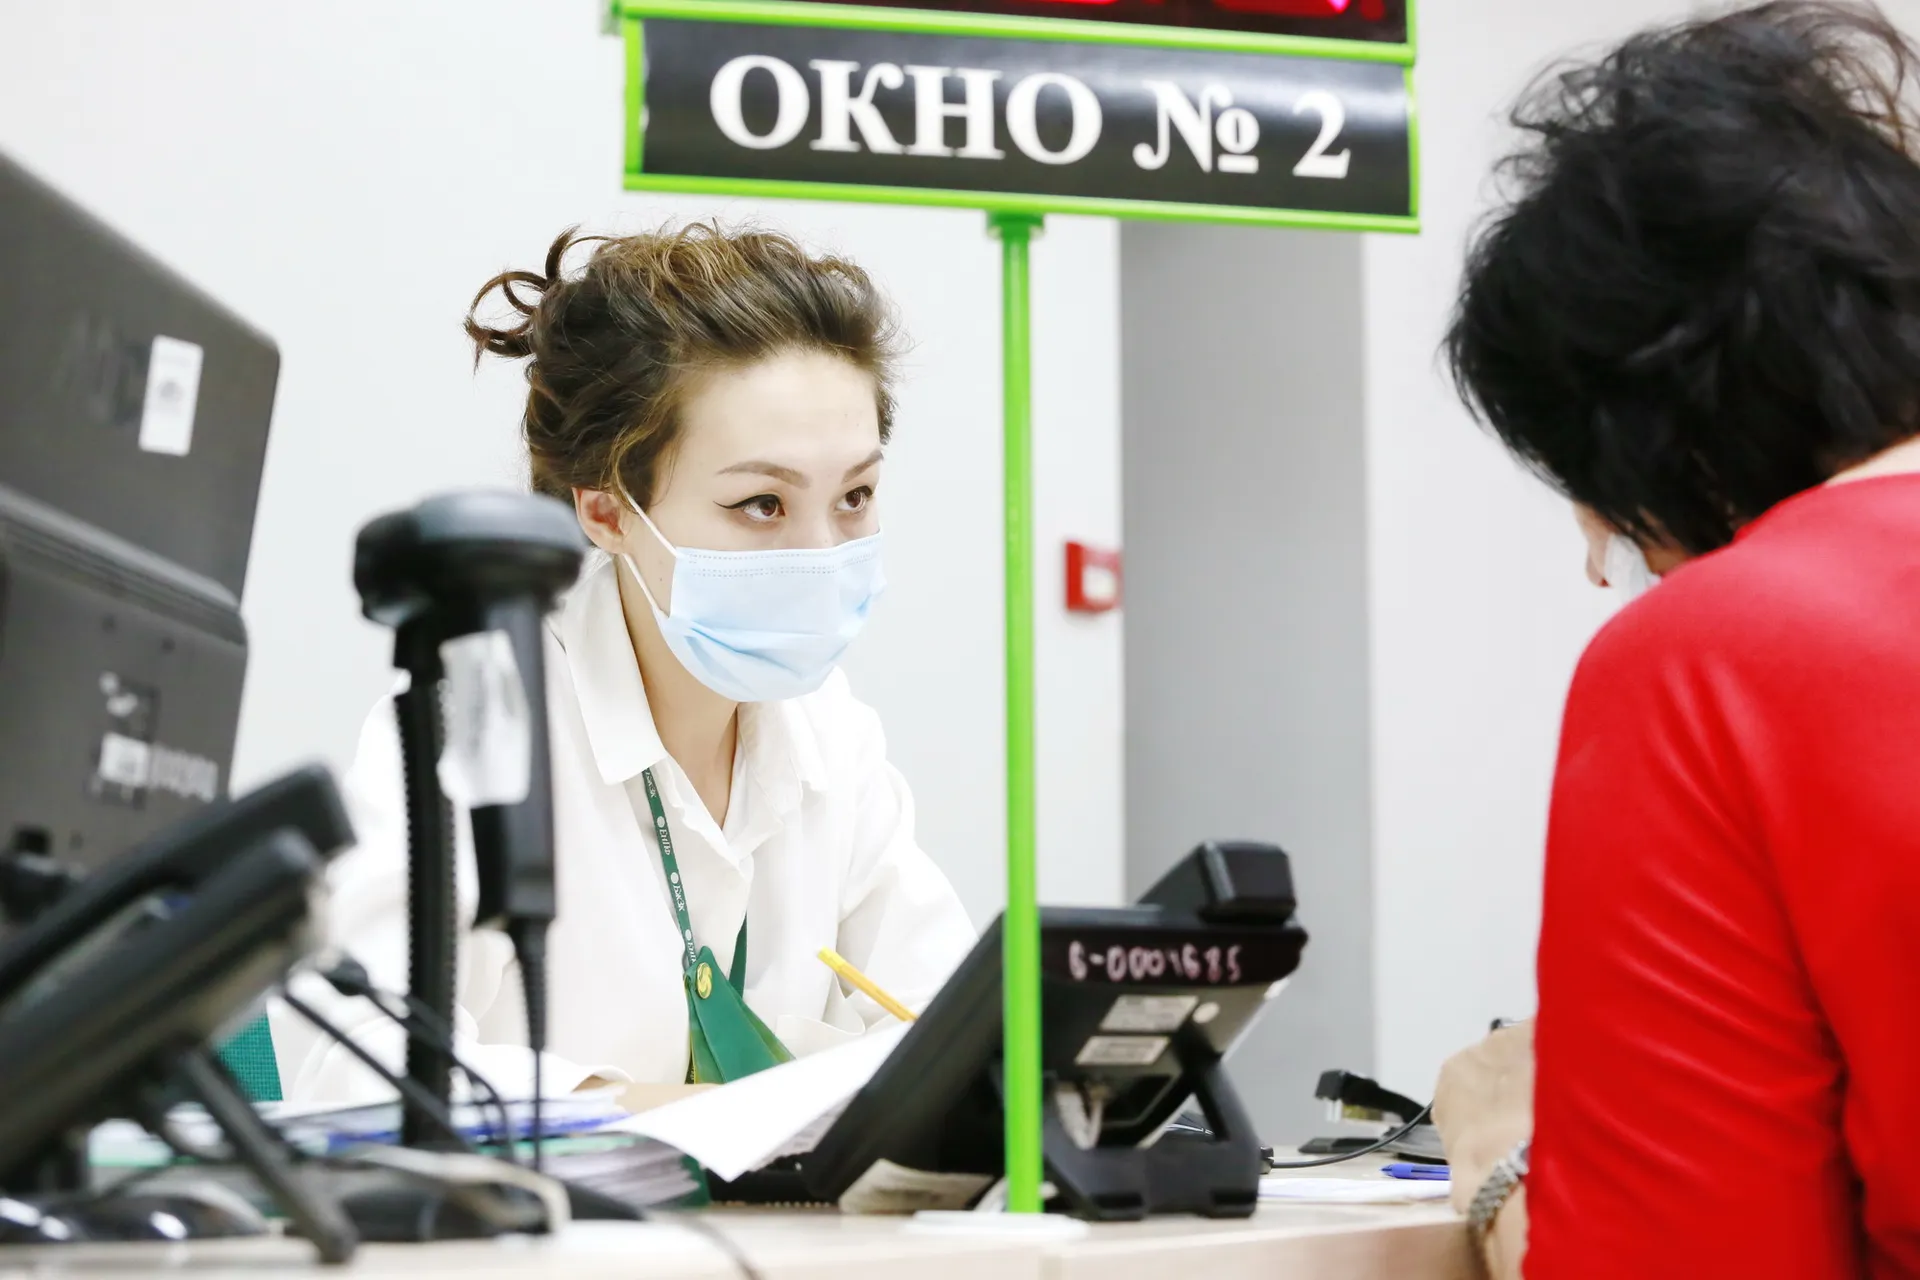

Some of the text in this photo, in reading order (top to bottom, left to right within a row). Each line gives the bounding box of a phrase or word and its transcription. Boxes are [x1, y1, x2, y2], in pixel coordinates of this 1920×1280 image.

[709, 54, 1351, 179] ОКНО № 2
